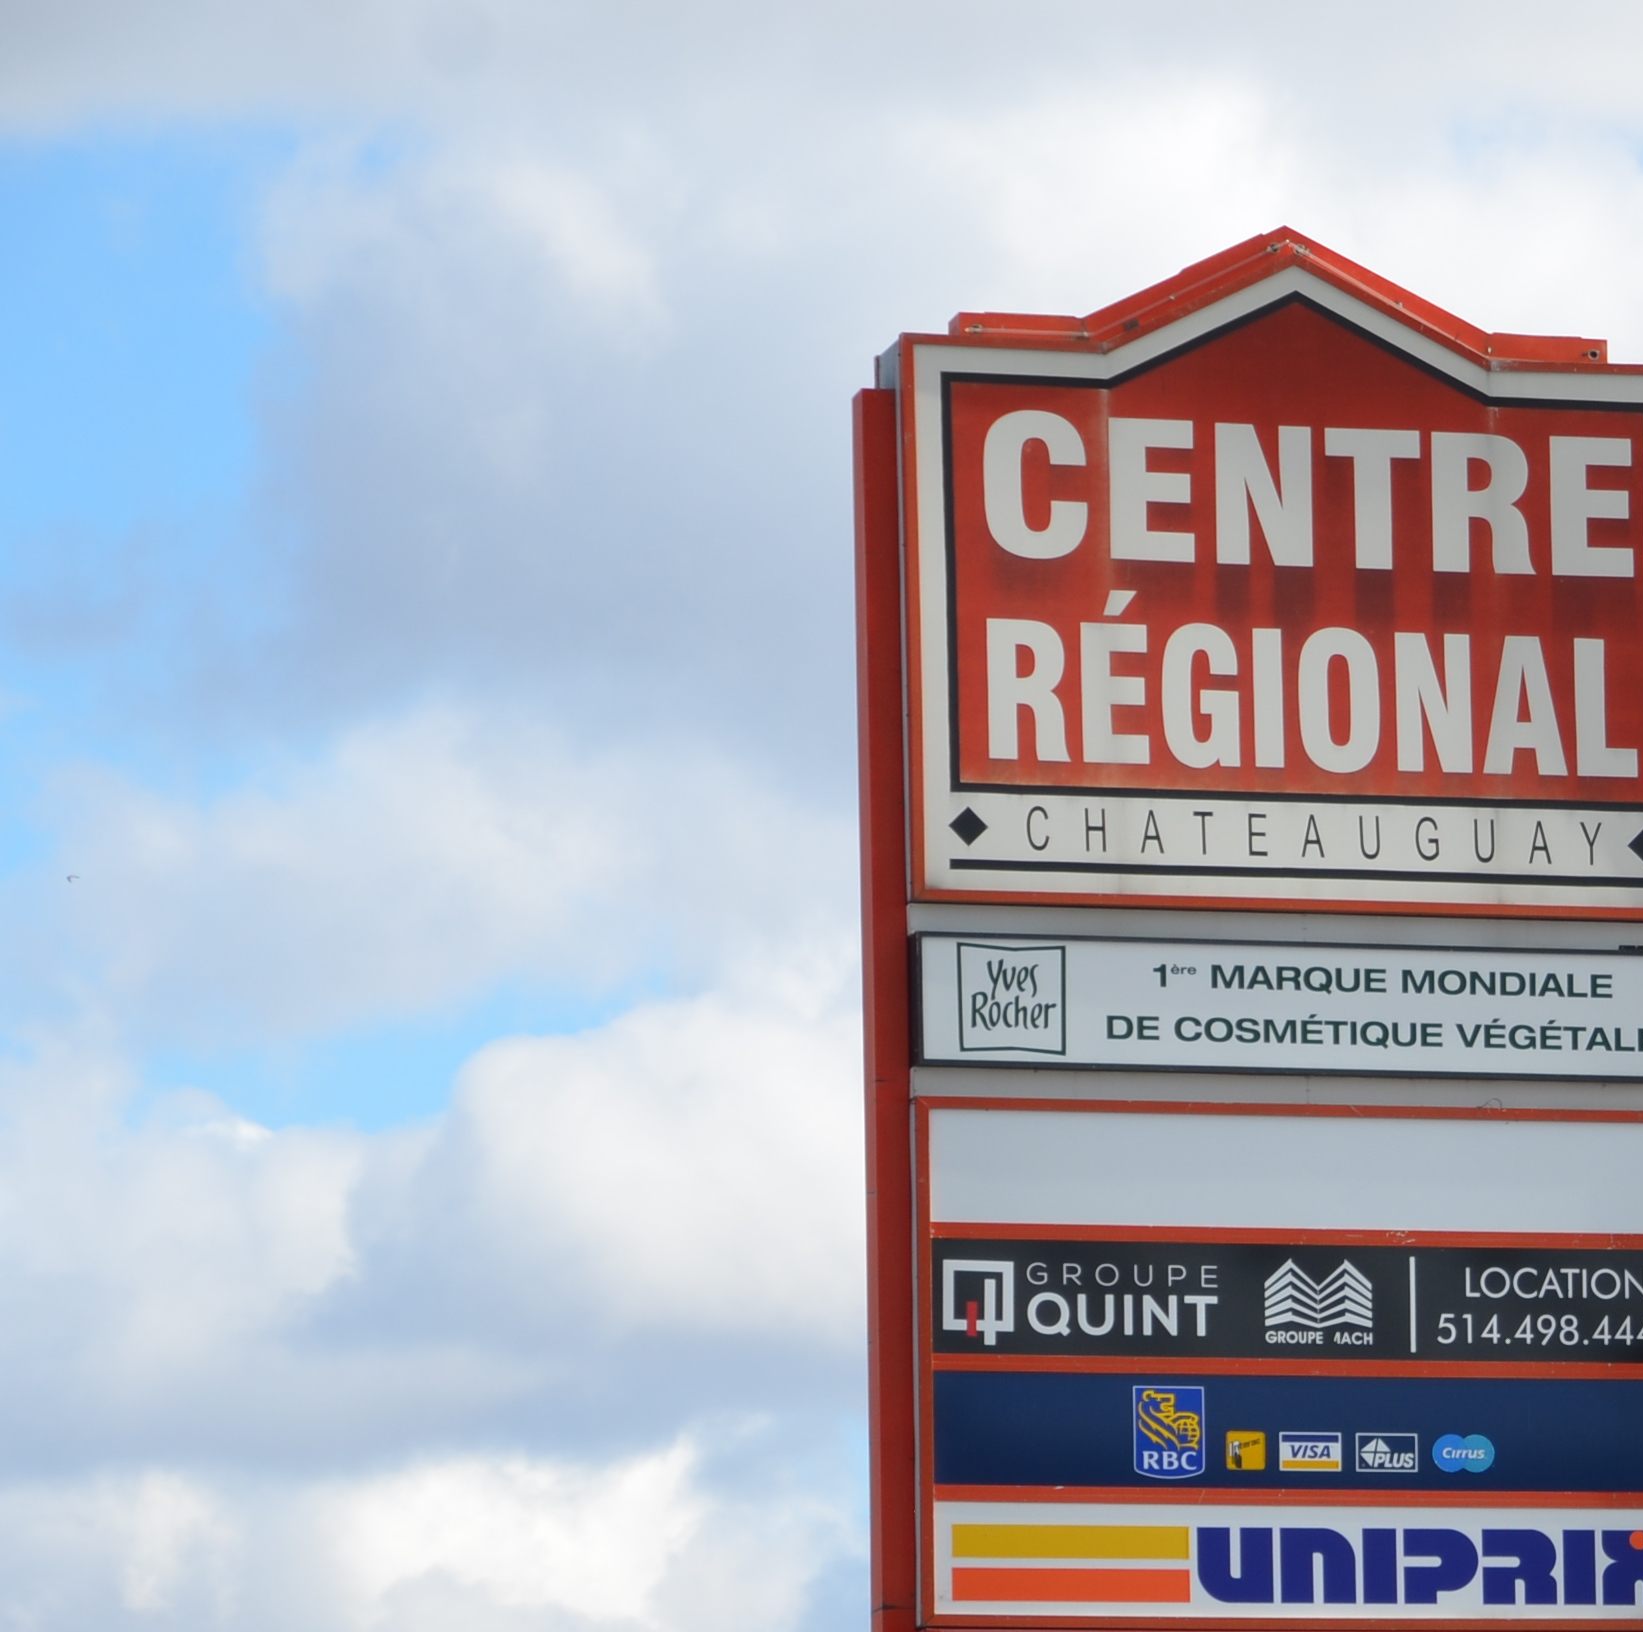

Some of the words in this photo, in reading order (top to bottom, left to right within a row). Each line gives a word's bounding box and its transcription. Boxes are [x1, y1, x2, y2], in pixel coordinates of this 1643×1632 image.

[983, 409, 1635, 579] CENTRE
[985, 589, 1640, 779] RÉGIONAL
[1025, 805, 1603, 867] CHATEAUGUAY
[985, 958, 1039, 997] Yves
[1152, 963, 1197, 988] 1ère
[1211, 964, 1387, 995] MARQUE
[1401, 969, 1613, 999] MONDIALE
[970, 992, 1057, 1033] Rocher
[1106, 1015, 1160, 1041] DE
[1174, 1013, 1443, 1049] COSMÉTIQUE
[1026, 1262, 1219, 1289] GROUPE
[1026, 1291, 1219, 1337] QUINT
[1264, 1331, 1324, 1345] GROUPE
[1142, 1450, 1197, 1471] RBC
[1290, 1444, 1332, 1459] VISA
[1372, 1452, 1415, 1468] PLUS
[1442, 1447, 1485, 1460] Cirrus
